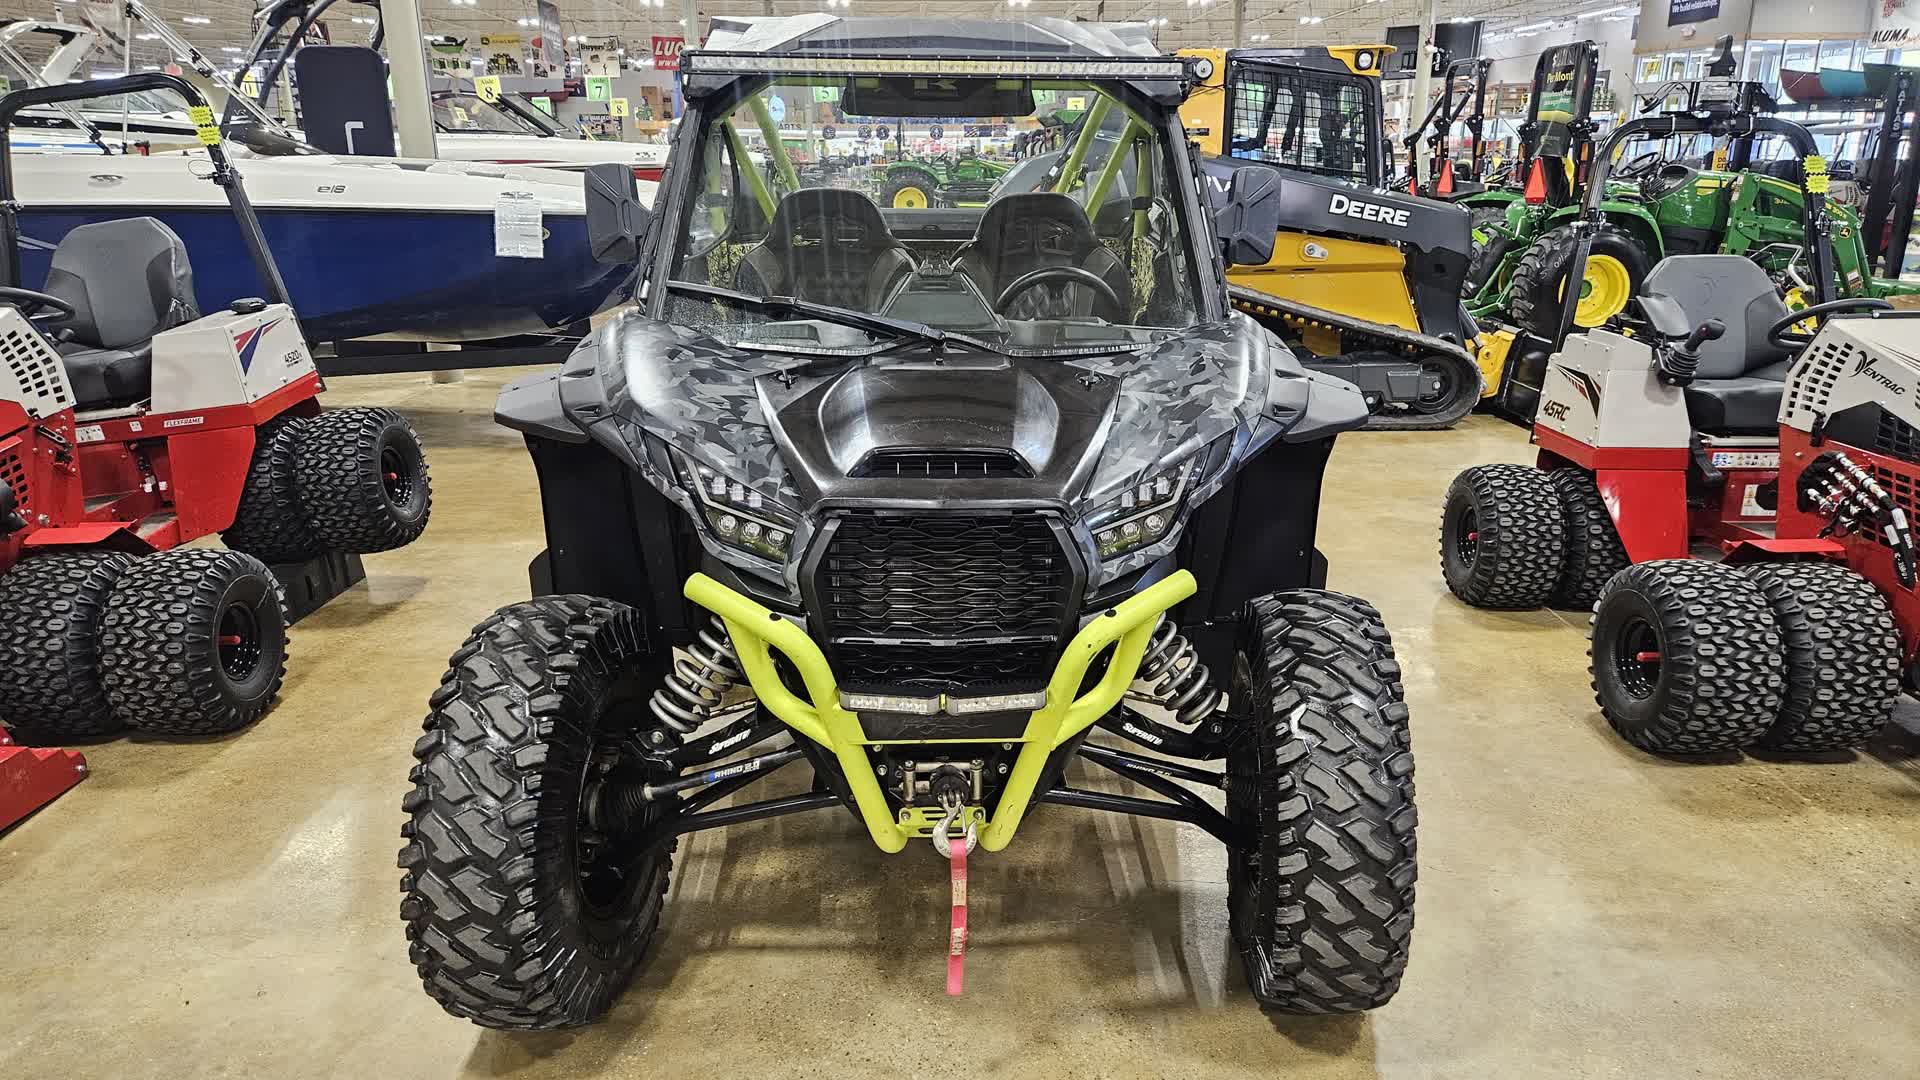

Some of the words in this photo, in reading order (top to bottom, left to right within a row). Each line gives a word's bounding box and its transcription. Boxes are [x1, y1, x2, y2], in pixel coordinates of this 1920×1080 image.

[1872, 28, 1910, 43] ALUMA
[485, 86, 494, 99] 8
[595, 85, 603, 98] 7
[1893, 90, 1906, 131] ATLAS
[1329, 193, 1411, 228] DEERE
[1848, 350, 1906, 395] VENTRAC
[1543, 400, 1571, 422] 45RC
[165, 417, 202, 428] FLEXFRAME
[714, 764, 744, 779] RHINO
